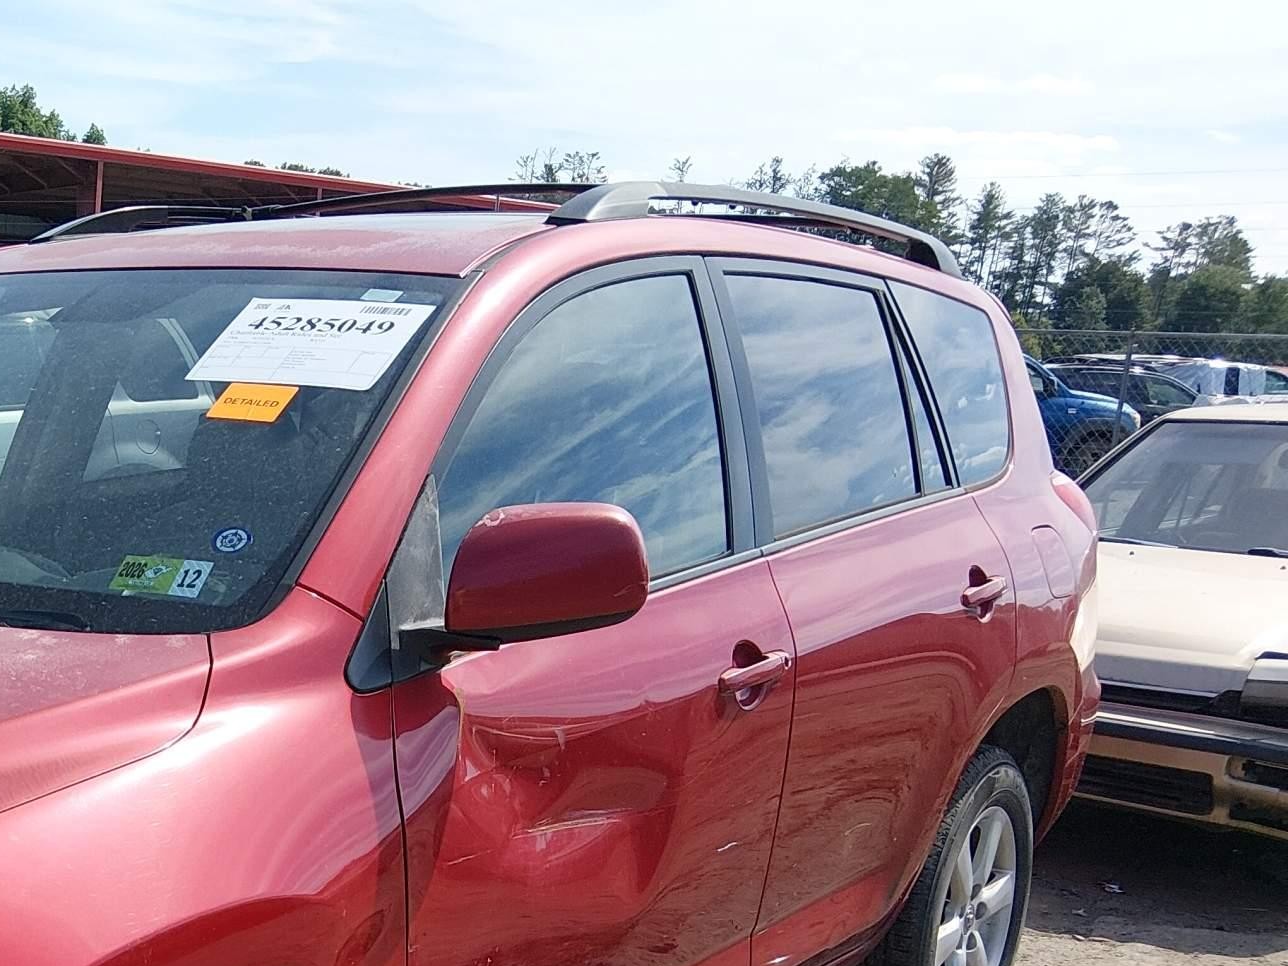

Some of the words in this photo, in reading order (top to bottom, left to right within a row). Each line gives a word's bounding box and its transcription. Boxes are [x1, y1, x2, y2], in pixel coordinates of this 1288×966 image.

[247, 315, 396, 336] 45285049
[223, 397, 280, 408] DETAILED
[117, 561, 148, 579] 2026
[176, 568, 203, 589] 12
